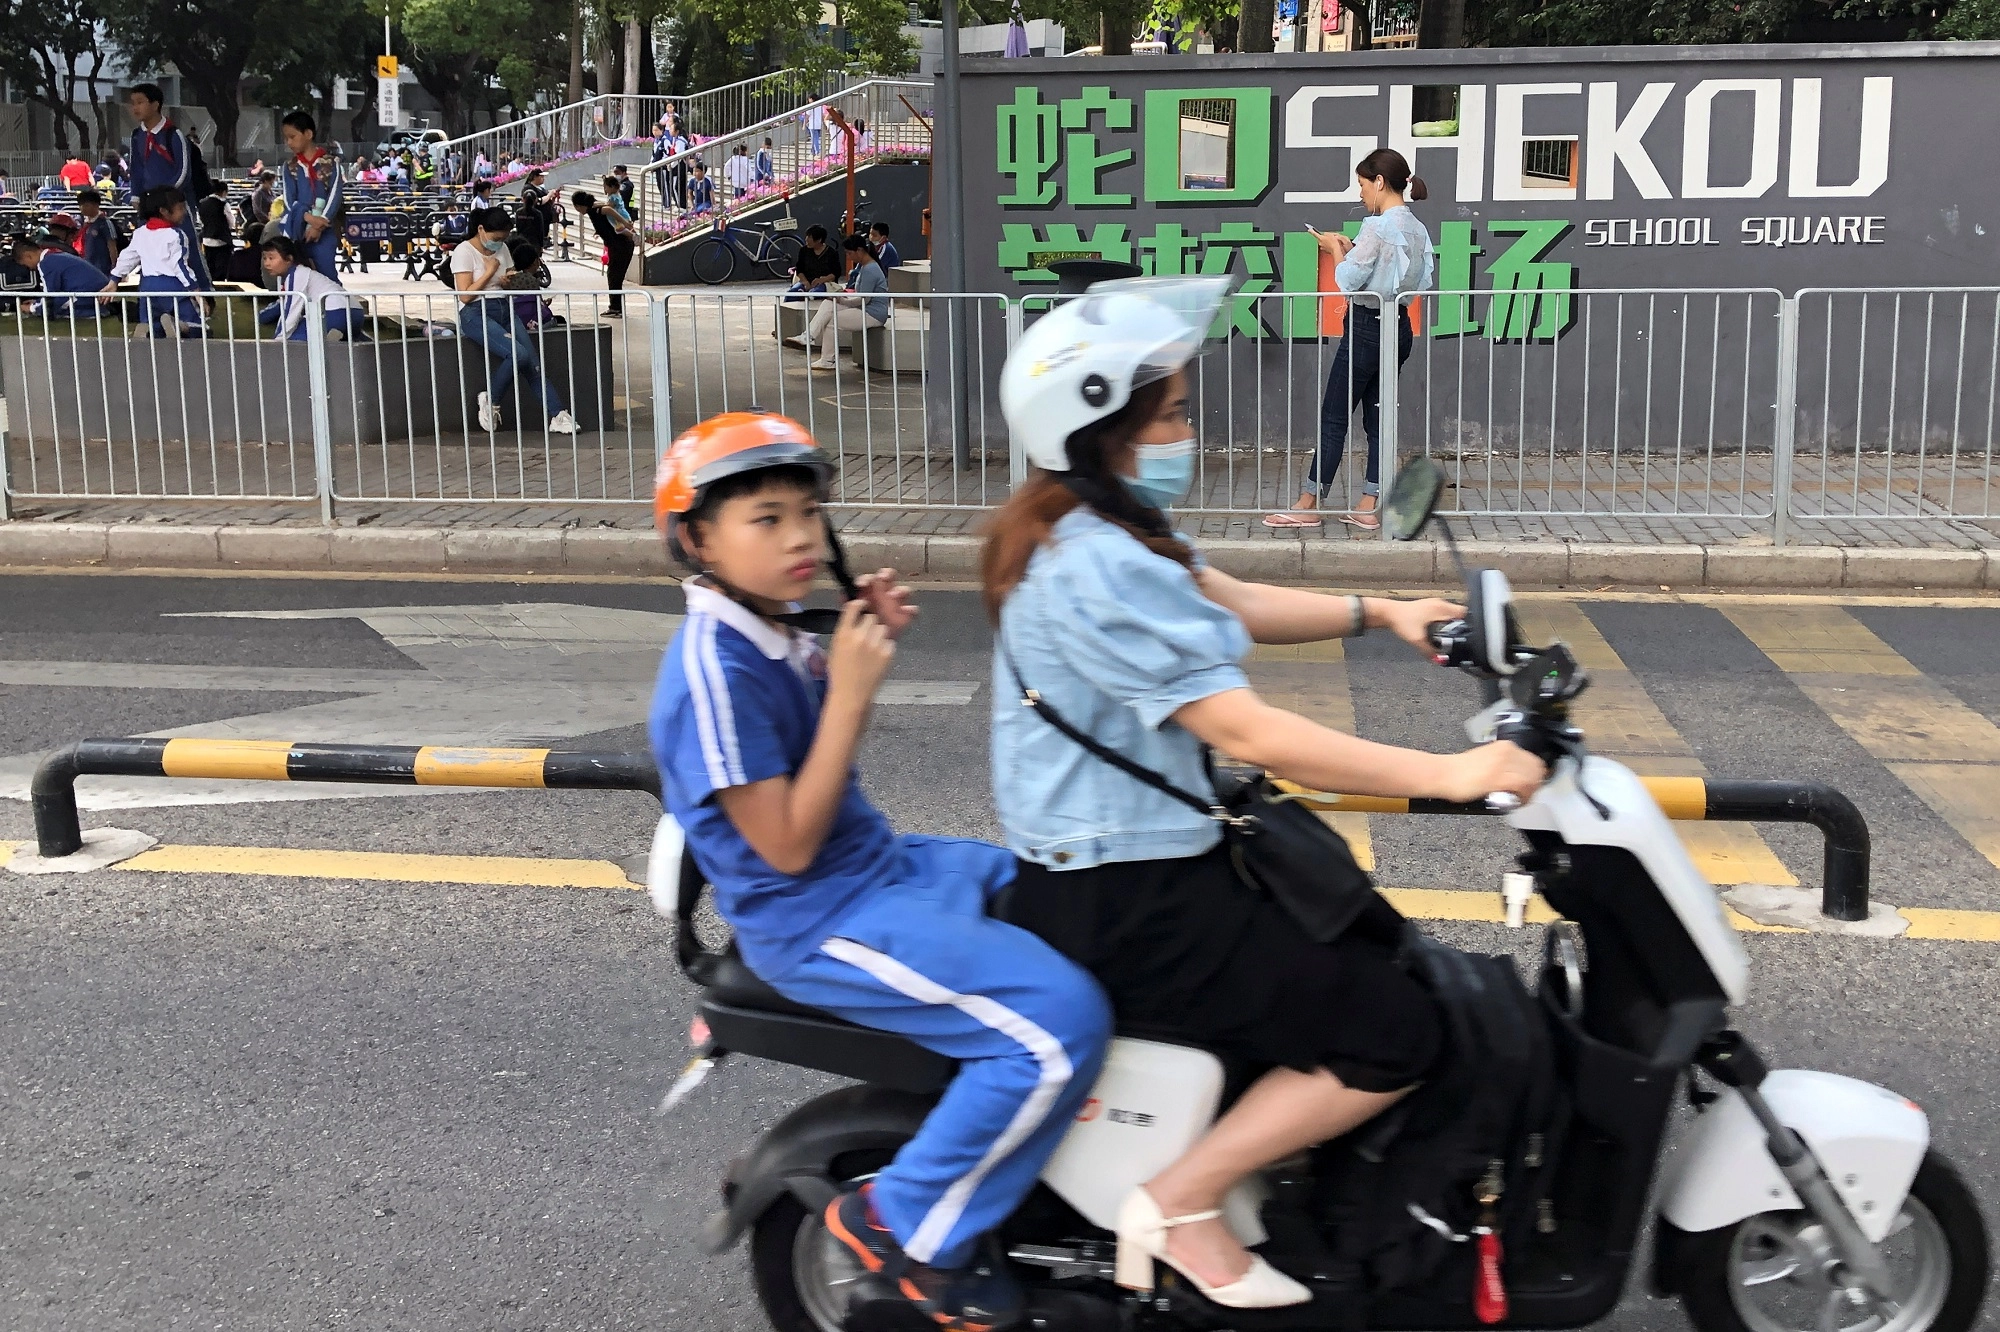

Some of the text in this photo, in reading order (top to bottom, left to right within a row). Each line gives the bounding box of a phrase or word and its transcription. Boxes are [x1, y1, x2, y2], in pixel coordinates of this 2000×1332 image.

[997, 86, 1271, 205] 蛇口
[1284, 76, 1893, 204] SHEKOU
[1584, 216, 1885, 248] SCHOOL SQUARE
